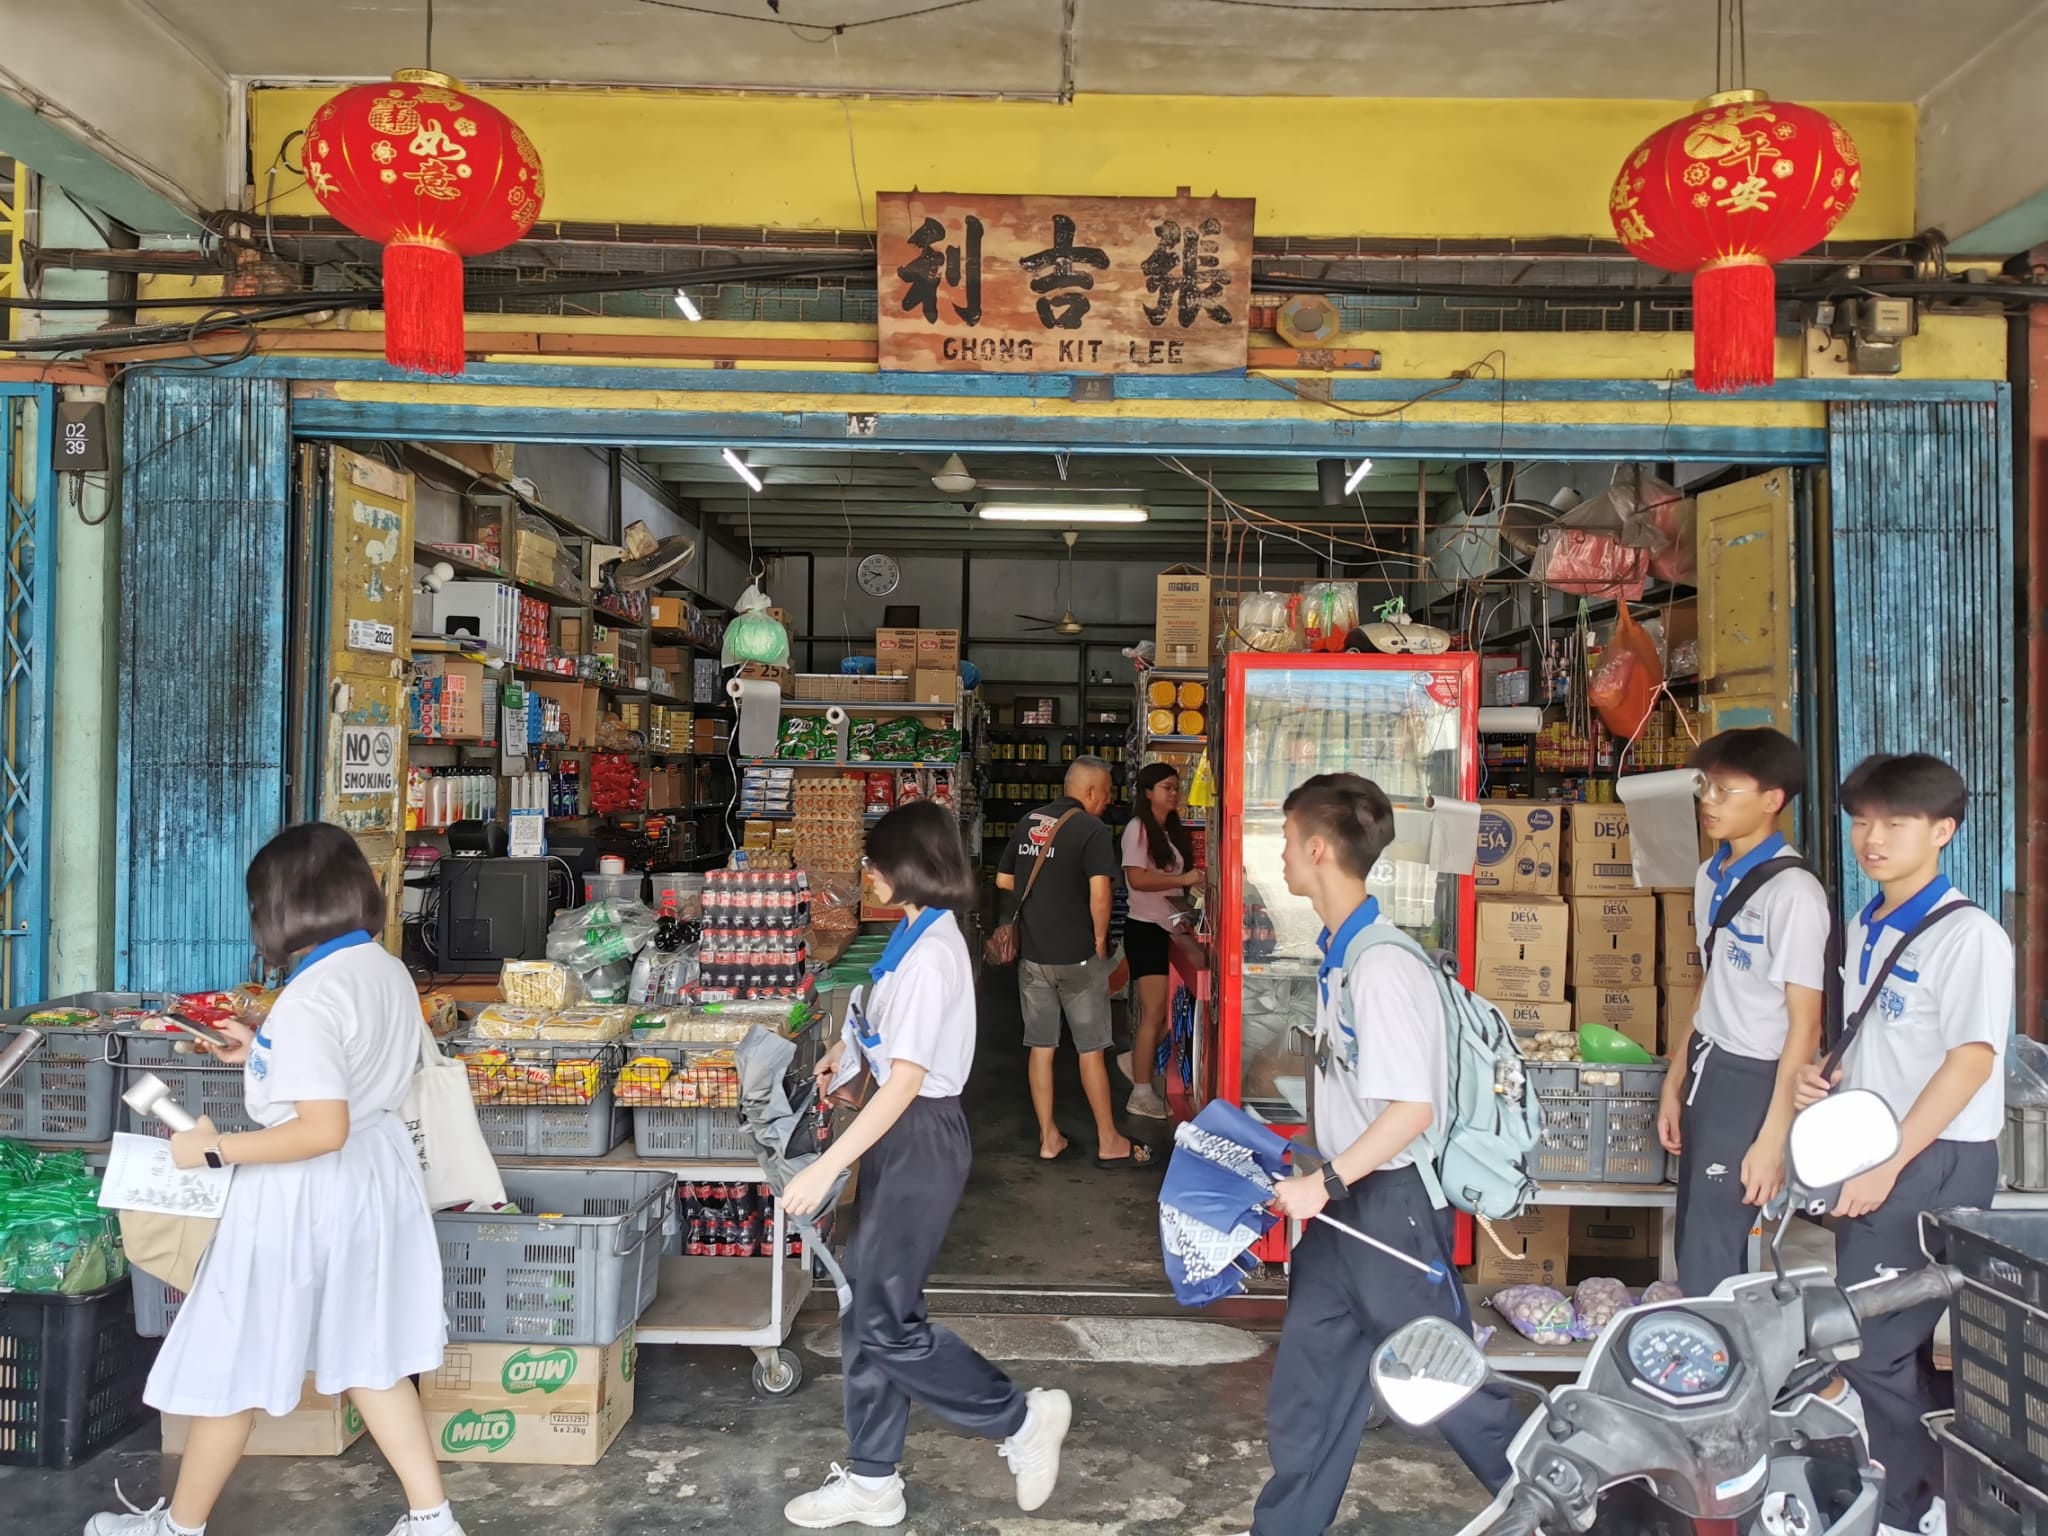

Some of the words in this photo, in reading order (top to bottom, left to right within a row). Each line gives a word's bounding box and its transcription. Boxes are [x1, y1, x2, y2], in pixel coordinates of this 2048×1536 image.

[1716, 130, 1781, 213] 平安
[943, 337, 1033, 361] CHONG
[1058, 338, 1103, 363] KIT
[1129, 340, 1185, 364] LEE
[65, 422, 86, 437] 02
[65, 440, 86, 454] 39
[375, 630, 393, 646] 2023
[346, 733, 370, 761] NO
[344, 773, 392, 789] SMOKING
[1478, 829, 1508, 850] ESA
[1511, 911, 1538, 923] DESA
[1603, 904, 1628, 916] DESA
[1605, 993, 1630, 1004] DESA
[1513, 1009, 1540, 1020] DESA
[509, 1359, 568, 1381] MILO
[451, 1421, 510, 1443] MILO
